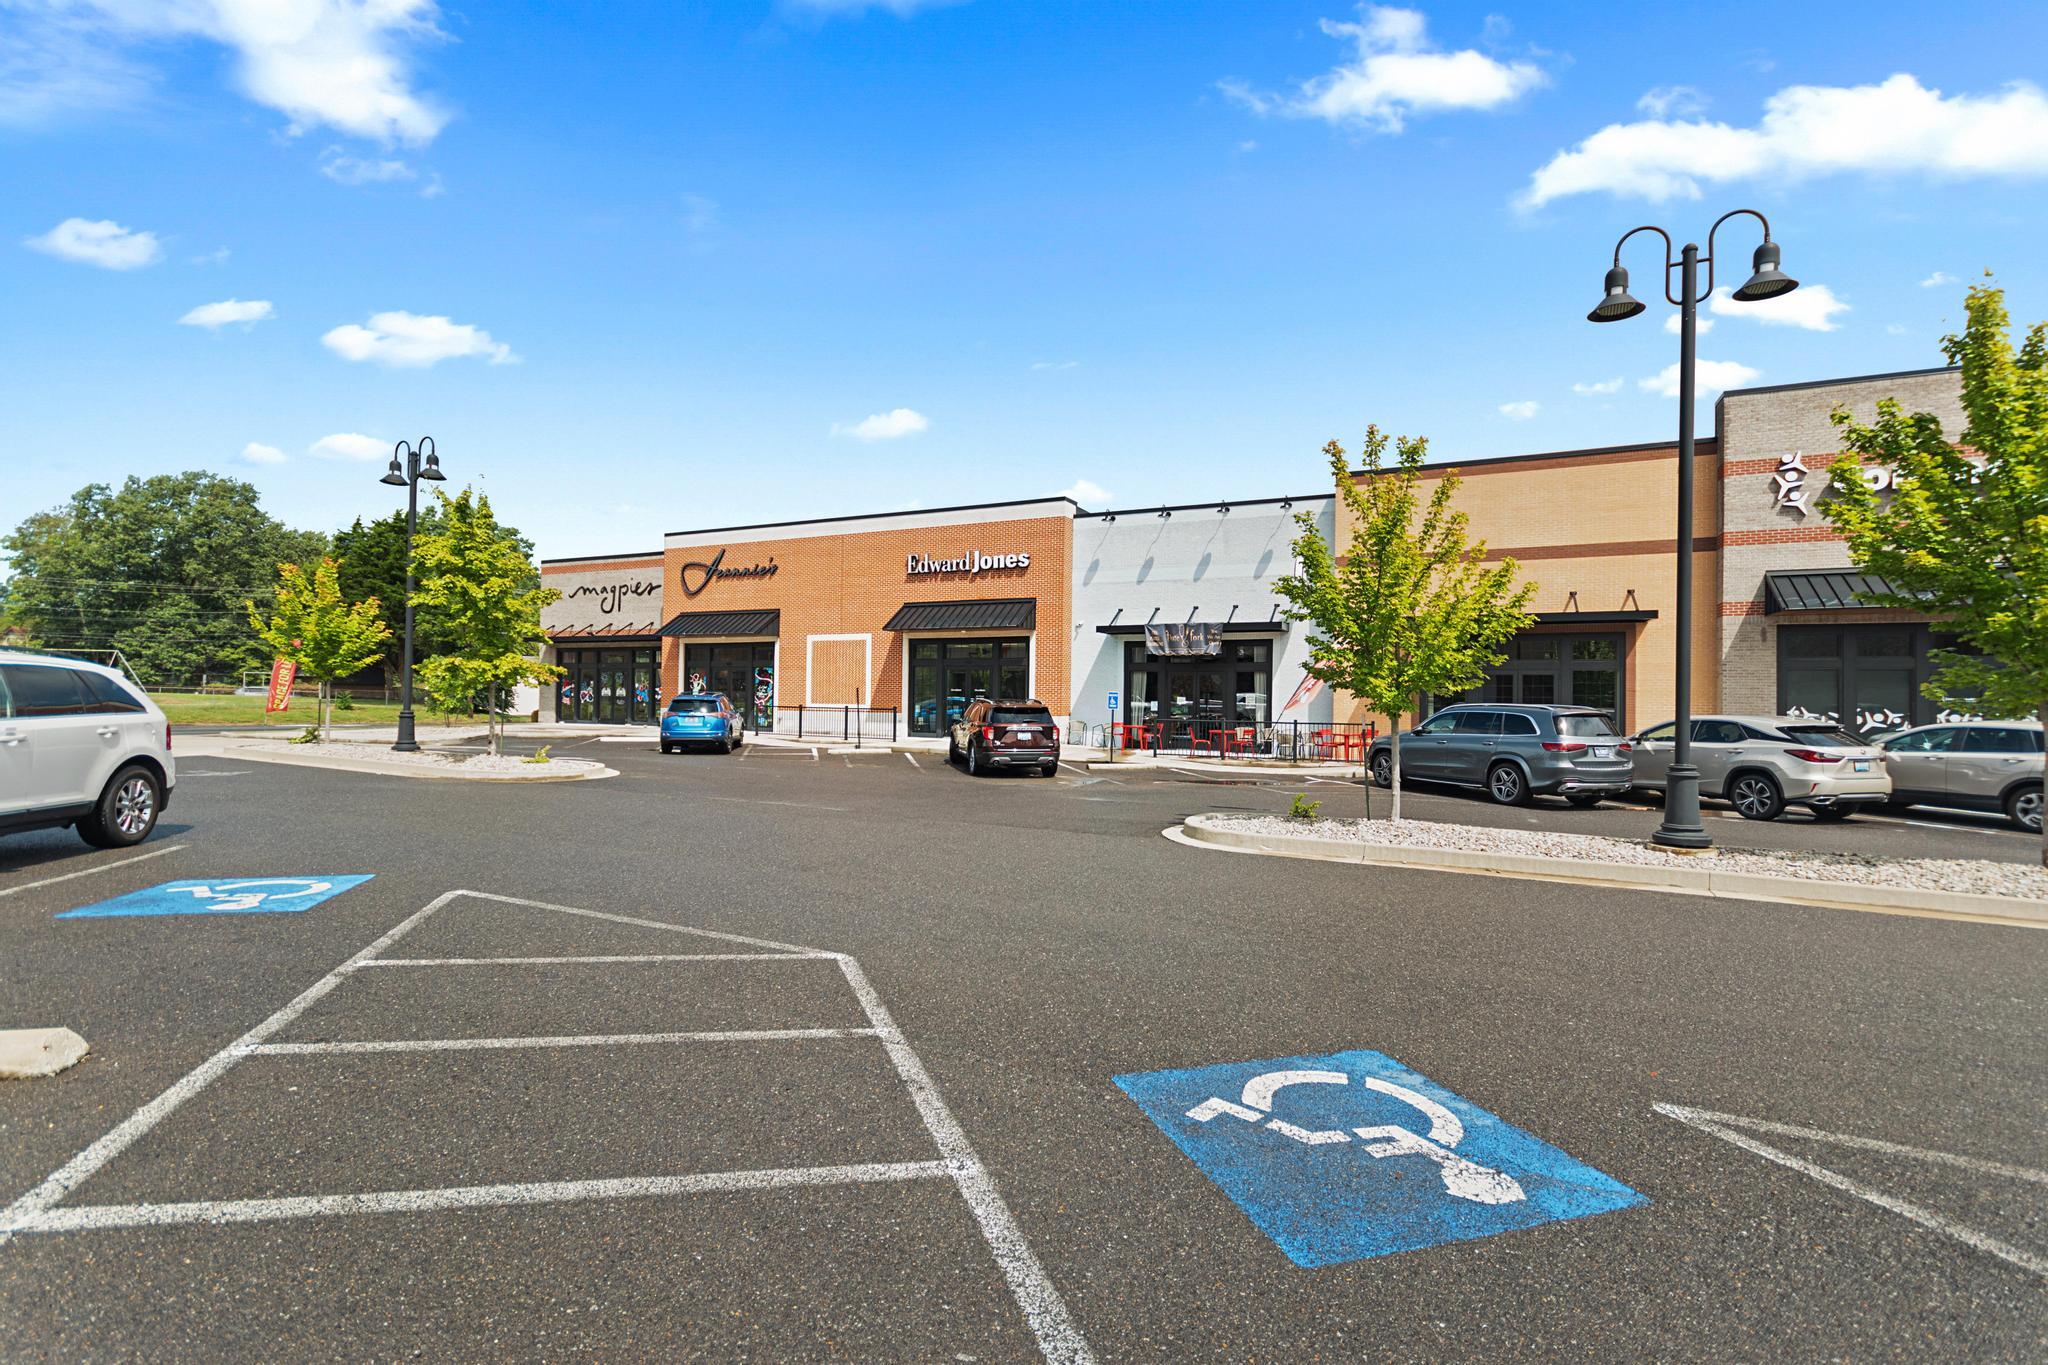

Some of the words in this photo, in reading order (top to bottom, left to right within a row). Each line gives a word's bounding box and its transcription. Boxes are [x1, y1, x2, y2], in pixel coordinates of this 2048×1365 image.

[906, 551, 970, 574] Edward
[971, 549, 1030, 573] Jones
[568, 577, 662, 614] magpies
[278, 668, 291, 687] FOR
